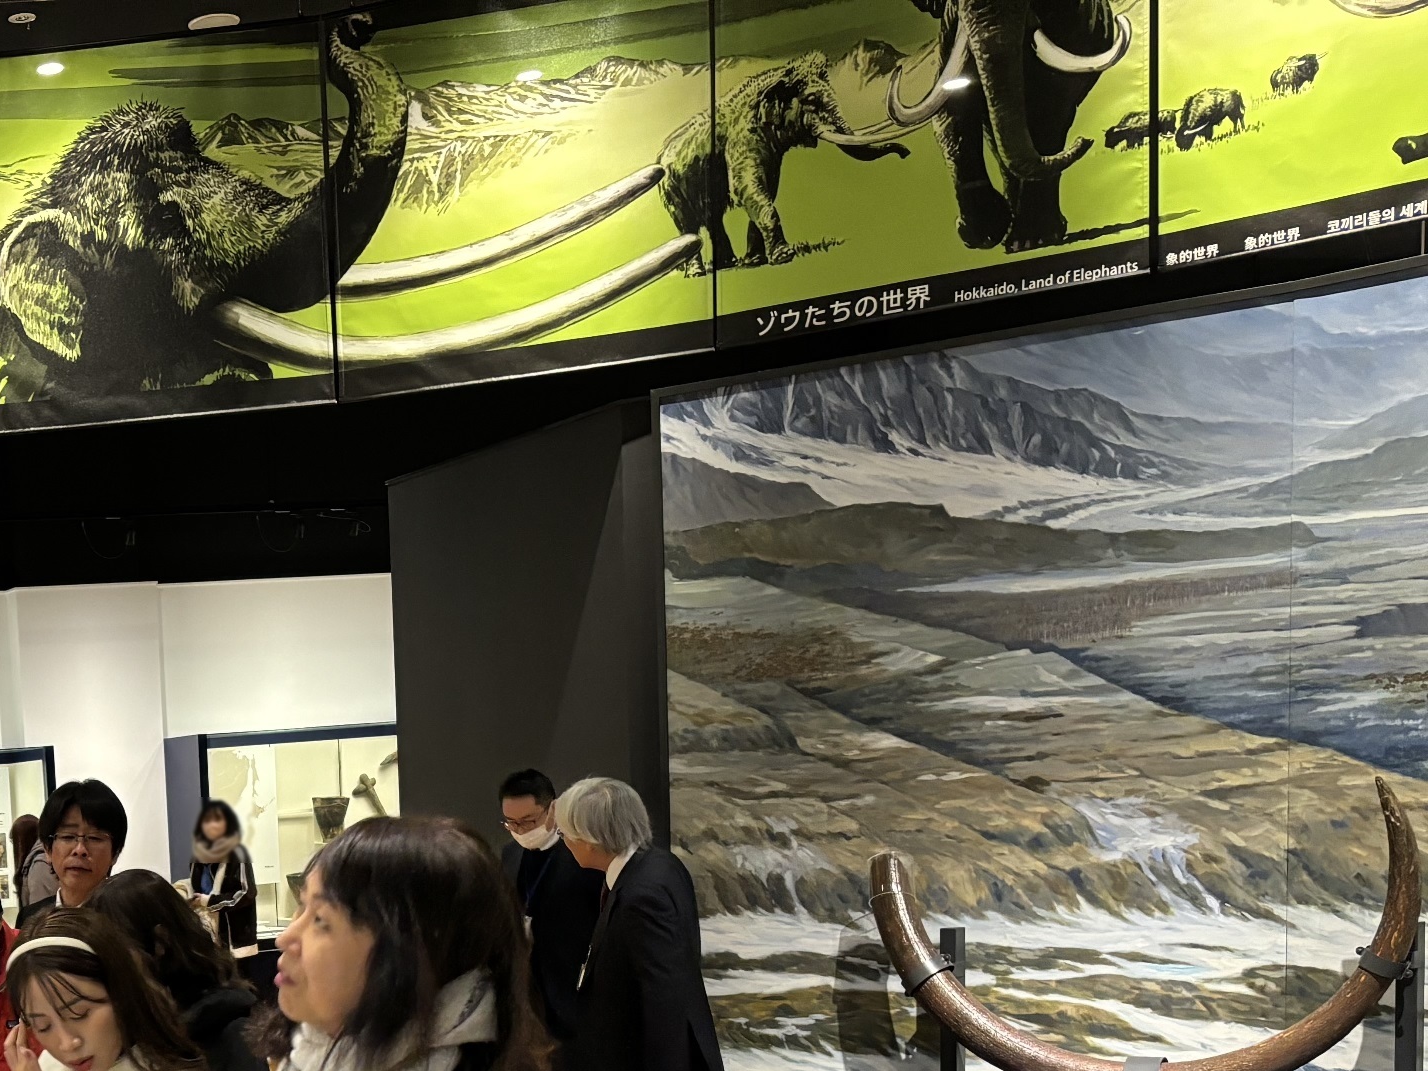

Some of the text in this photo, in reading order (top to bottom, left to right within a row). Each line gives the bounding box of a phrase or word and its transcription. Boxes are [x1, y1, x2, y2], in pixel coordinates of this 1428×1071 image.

[1327, 200, 1428, 234] 코끼리들의 세계
[1165, 243, 1219, 266] 象的世界
[1243, 227, 1301, 250] 象的世界
[954, 259, 1139, 303] Hokkaido, Land of Elephants
[756, 284, 931, 337] ゾウたちの世界
